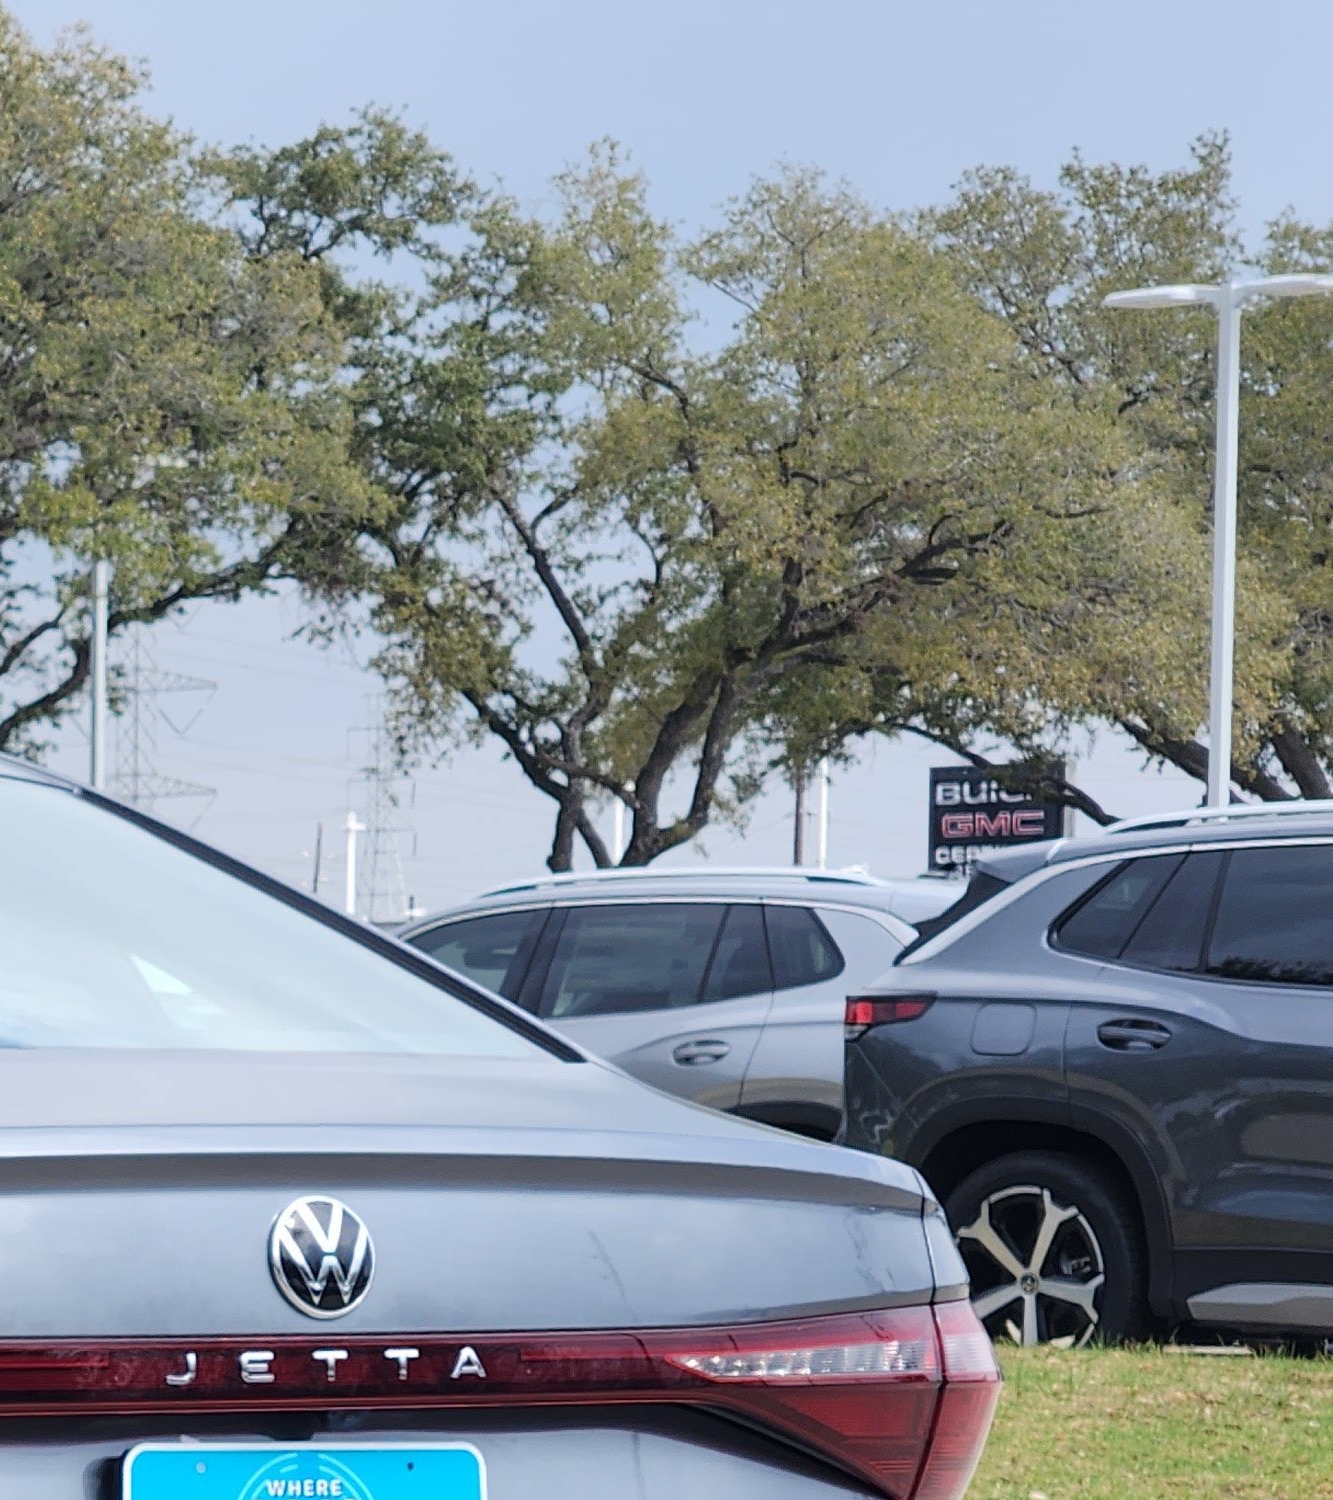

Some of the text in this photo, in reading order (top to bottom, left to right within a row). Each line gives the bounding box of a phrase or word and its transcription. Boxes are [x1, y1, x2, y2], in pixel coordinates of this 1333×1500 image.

[935, 780, 1033, 806] BUI
[941, 809, 1045, 838] GMC
[165, 1345, 488, 1386] JETTA
[266, 1479, 344, 1498] WHERE
